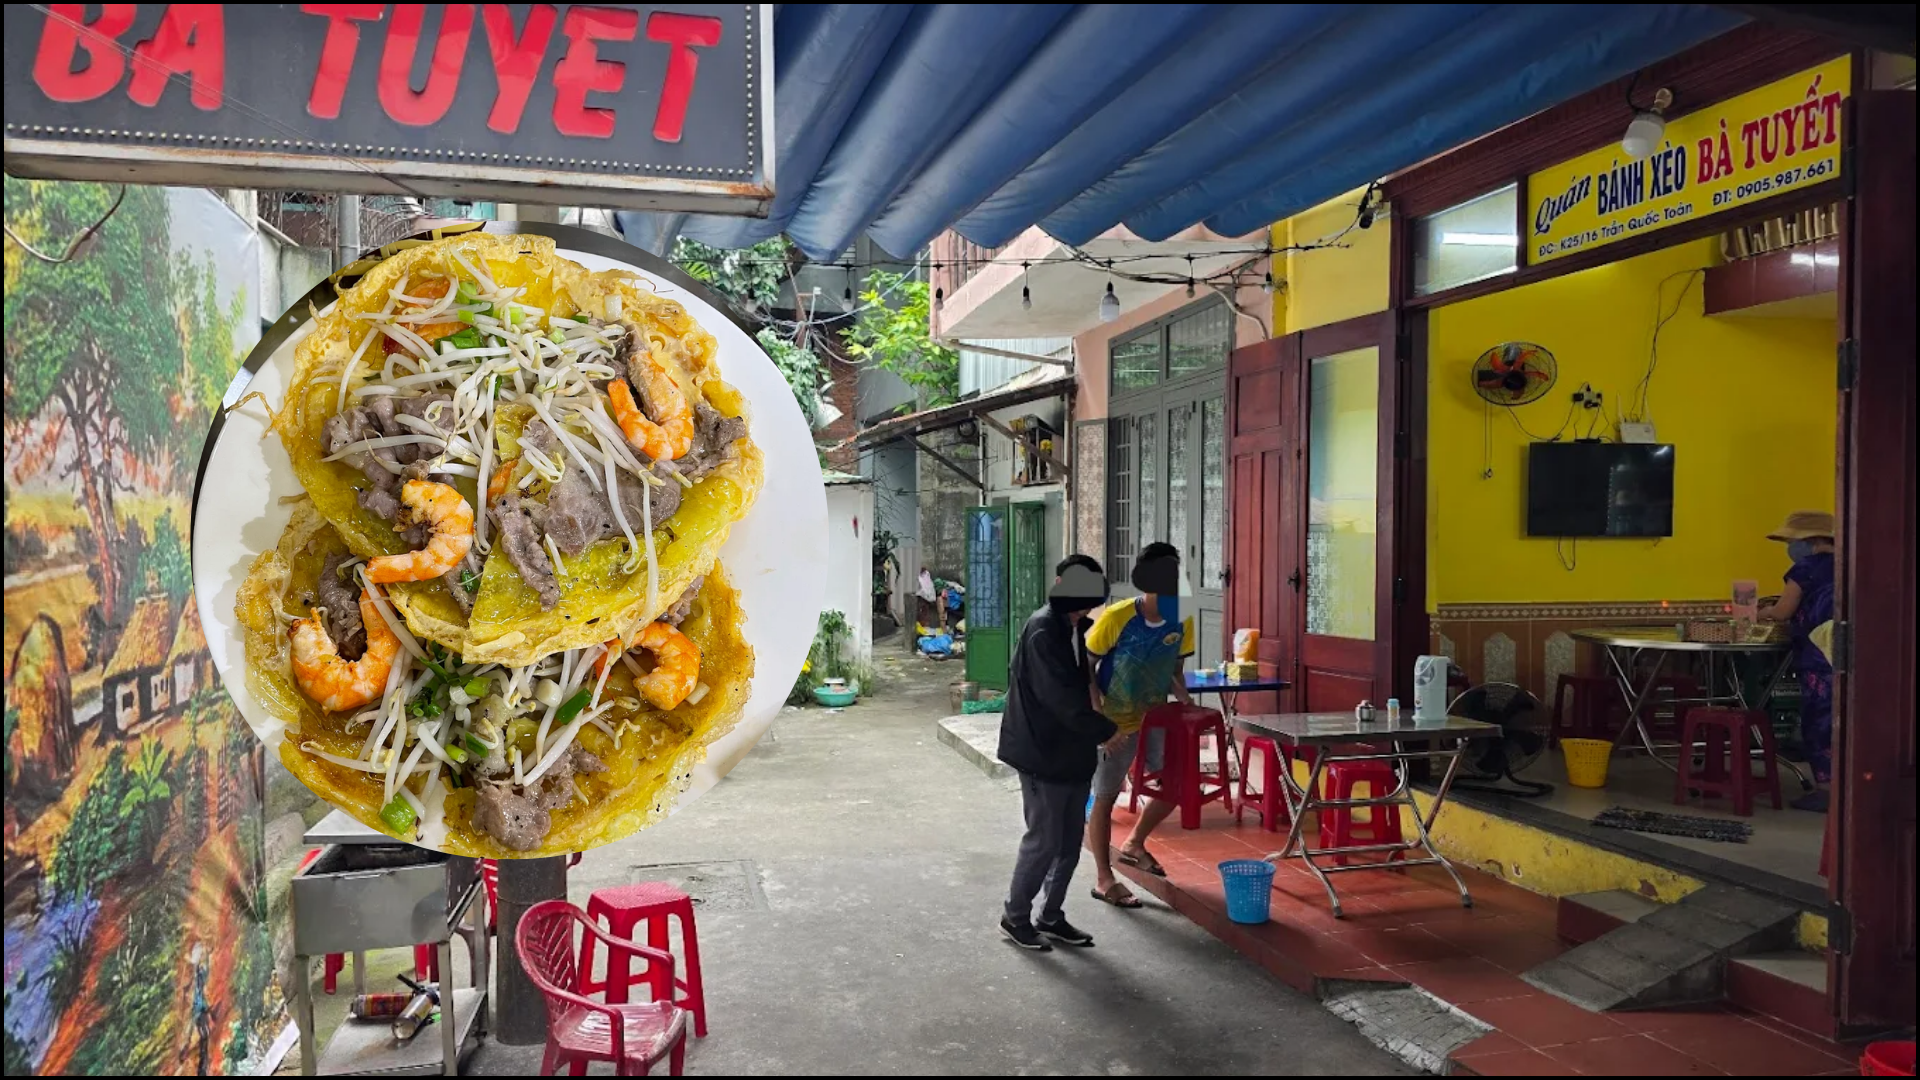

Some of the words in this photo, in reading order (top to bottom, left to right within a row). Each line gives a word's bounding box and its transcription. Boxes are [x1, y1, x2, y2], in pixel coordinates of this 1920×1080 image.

[1534, 174, 1591, 236] Quán
[1597, 159, 1644, 215] BÁNH
[1650, 141, 1687, 199] XÈO
[1697, 118, 1734, 184] BÀ
[1742, 74, 1841, 169] TUYẾT
[1560, 230, 1598, 250] K25/16
[1628, 209, 1660, 230] Quốc
[1713, 188, 1732, 206] ĐT:
[1737, 159, 1833, 199] 0905.987.661
